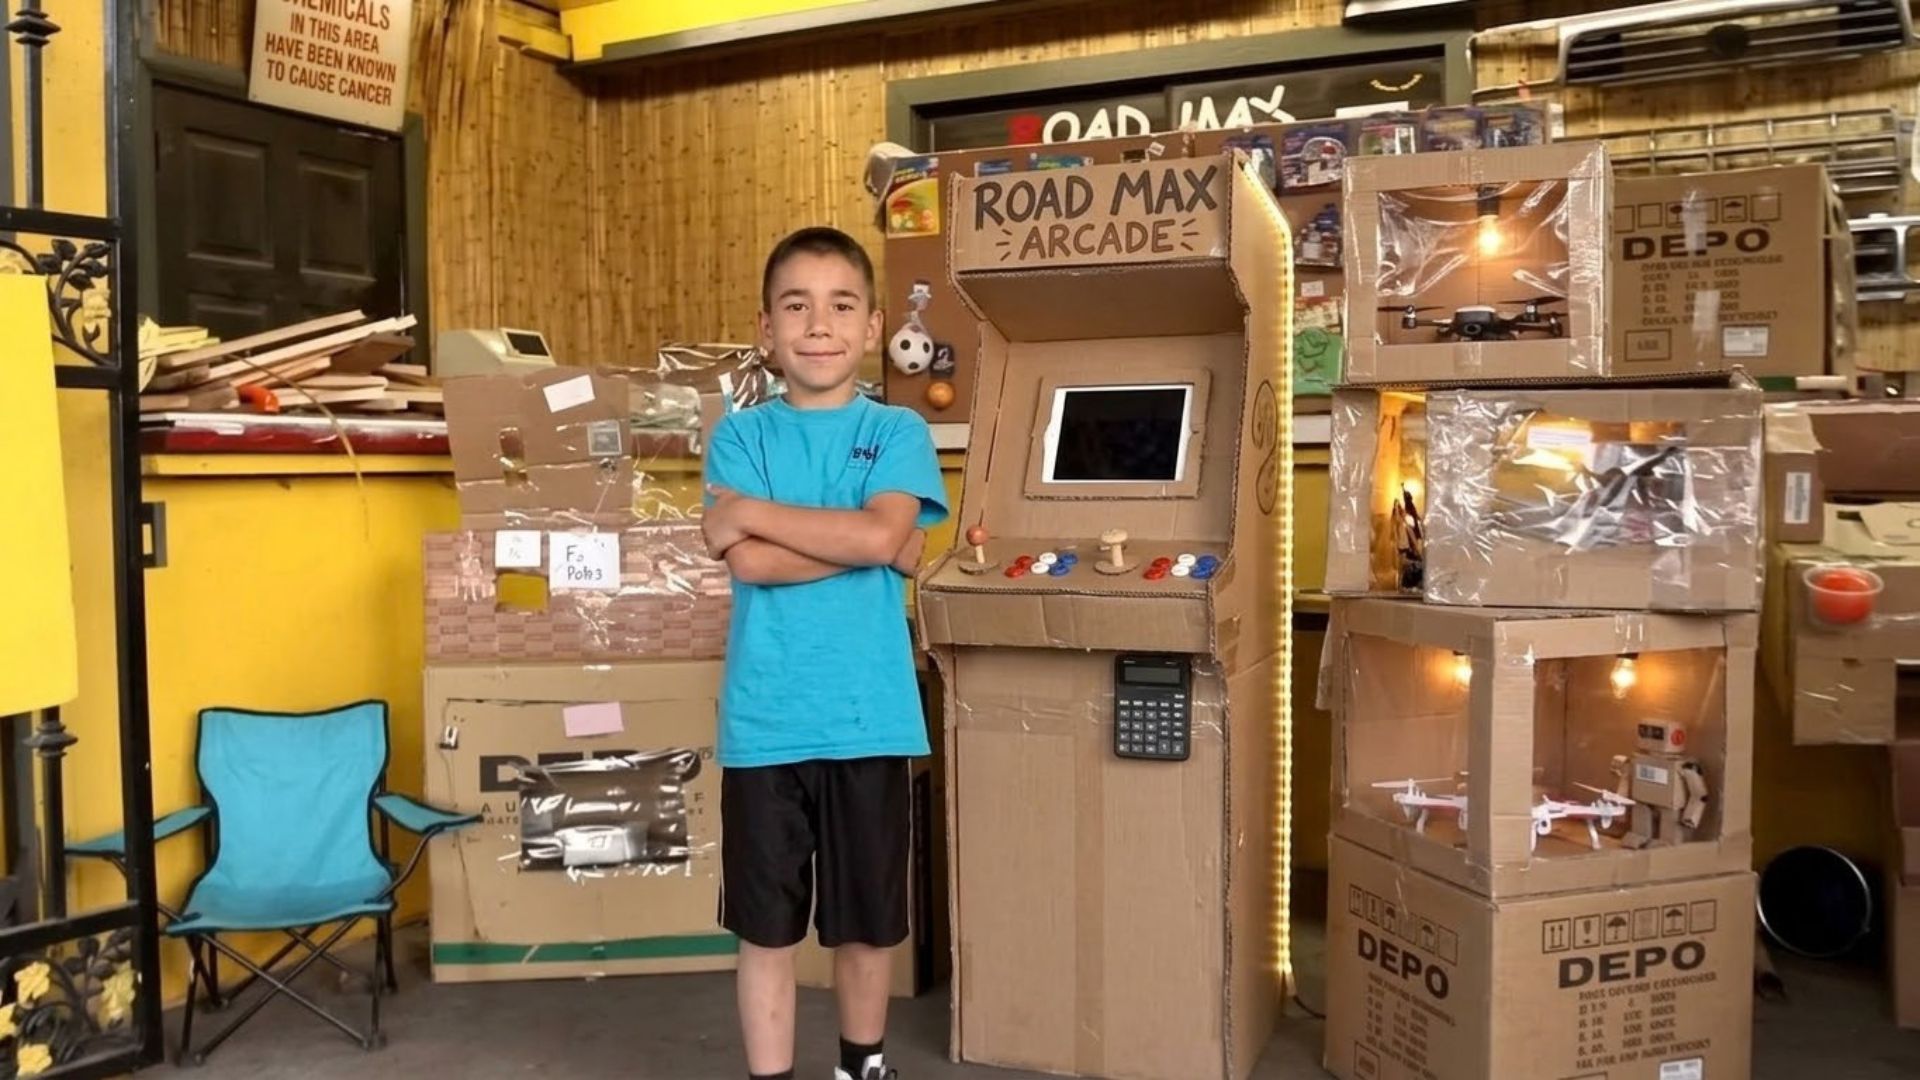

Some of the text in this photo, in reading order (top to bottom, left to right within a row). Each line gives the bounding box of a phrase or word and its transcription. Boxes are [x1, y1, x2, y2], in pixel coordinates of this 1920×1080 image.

[290, 12, 380, 54] IN THIS AREA
[265, 32, 397, 83] HAVE BEEN KNOWN
[266, 59, 393, 106] TO CAUSE CANCER
[973, 164, 1219, 232] ROAD MAX
[1018, 218, 1177, 260] ARCADE
[1622, 227, 1770, 262] DEPO
[1357, 927, 1450, 1000] DEPO
[1558, 940, 1707, 990] DEPO
